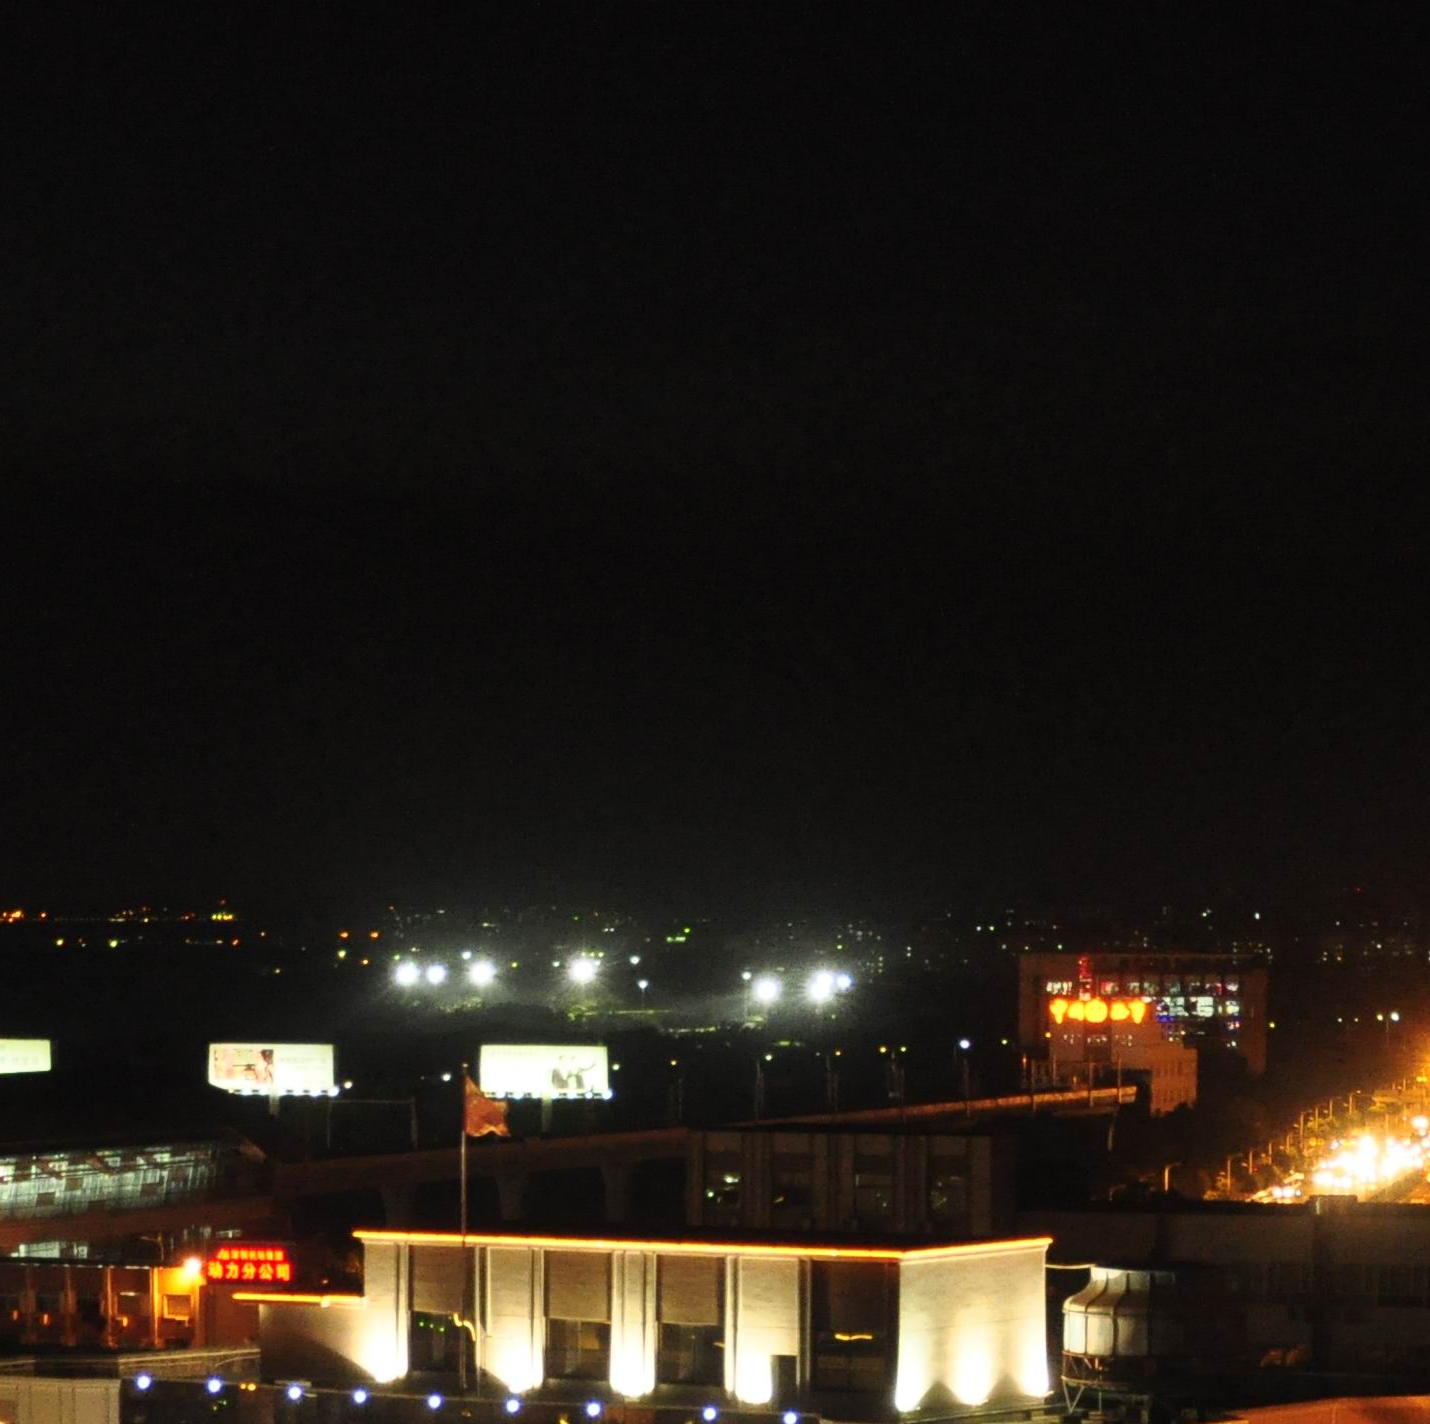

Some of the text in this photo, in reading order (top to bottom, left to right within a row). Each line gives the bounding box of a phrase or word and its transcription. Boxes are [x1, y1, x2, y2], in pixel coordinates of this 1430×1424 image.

[208, 1261, 291, 1282] 动力分公司
